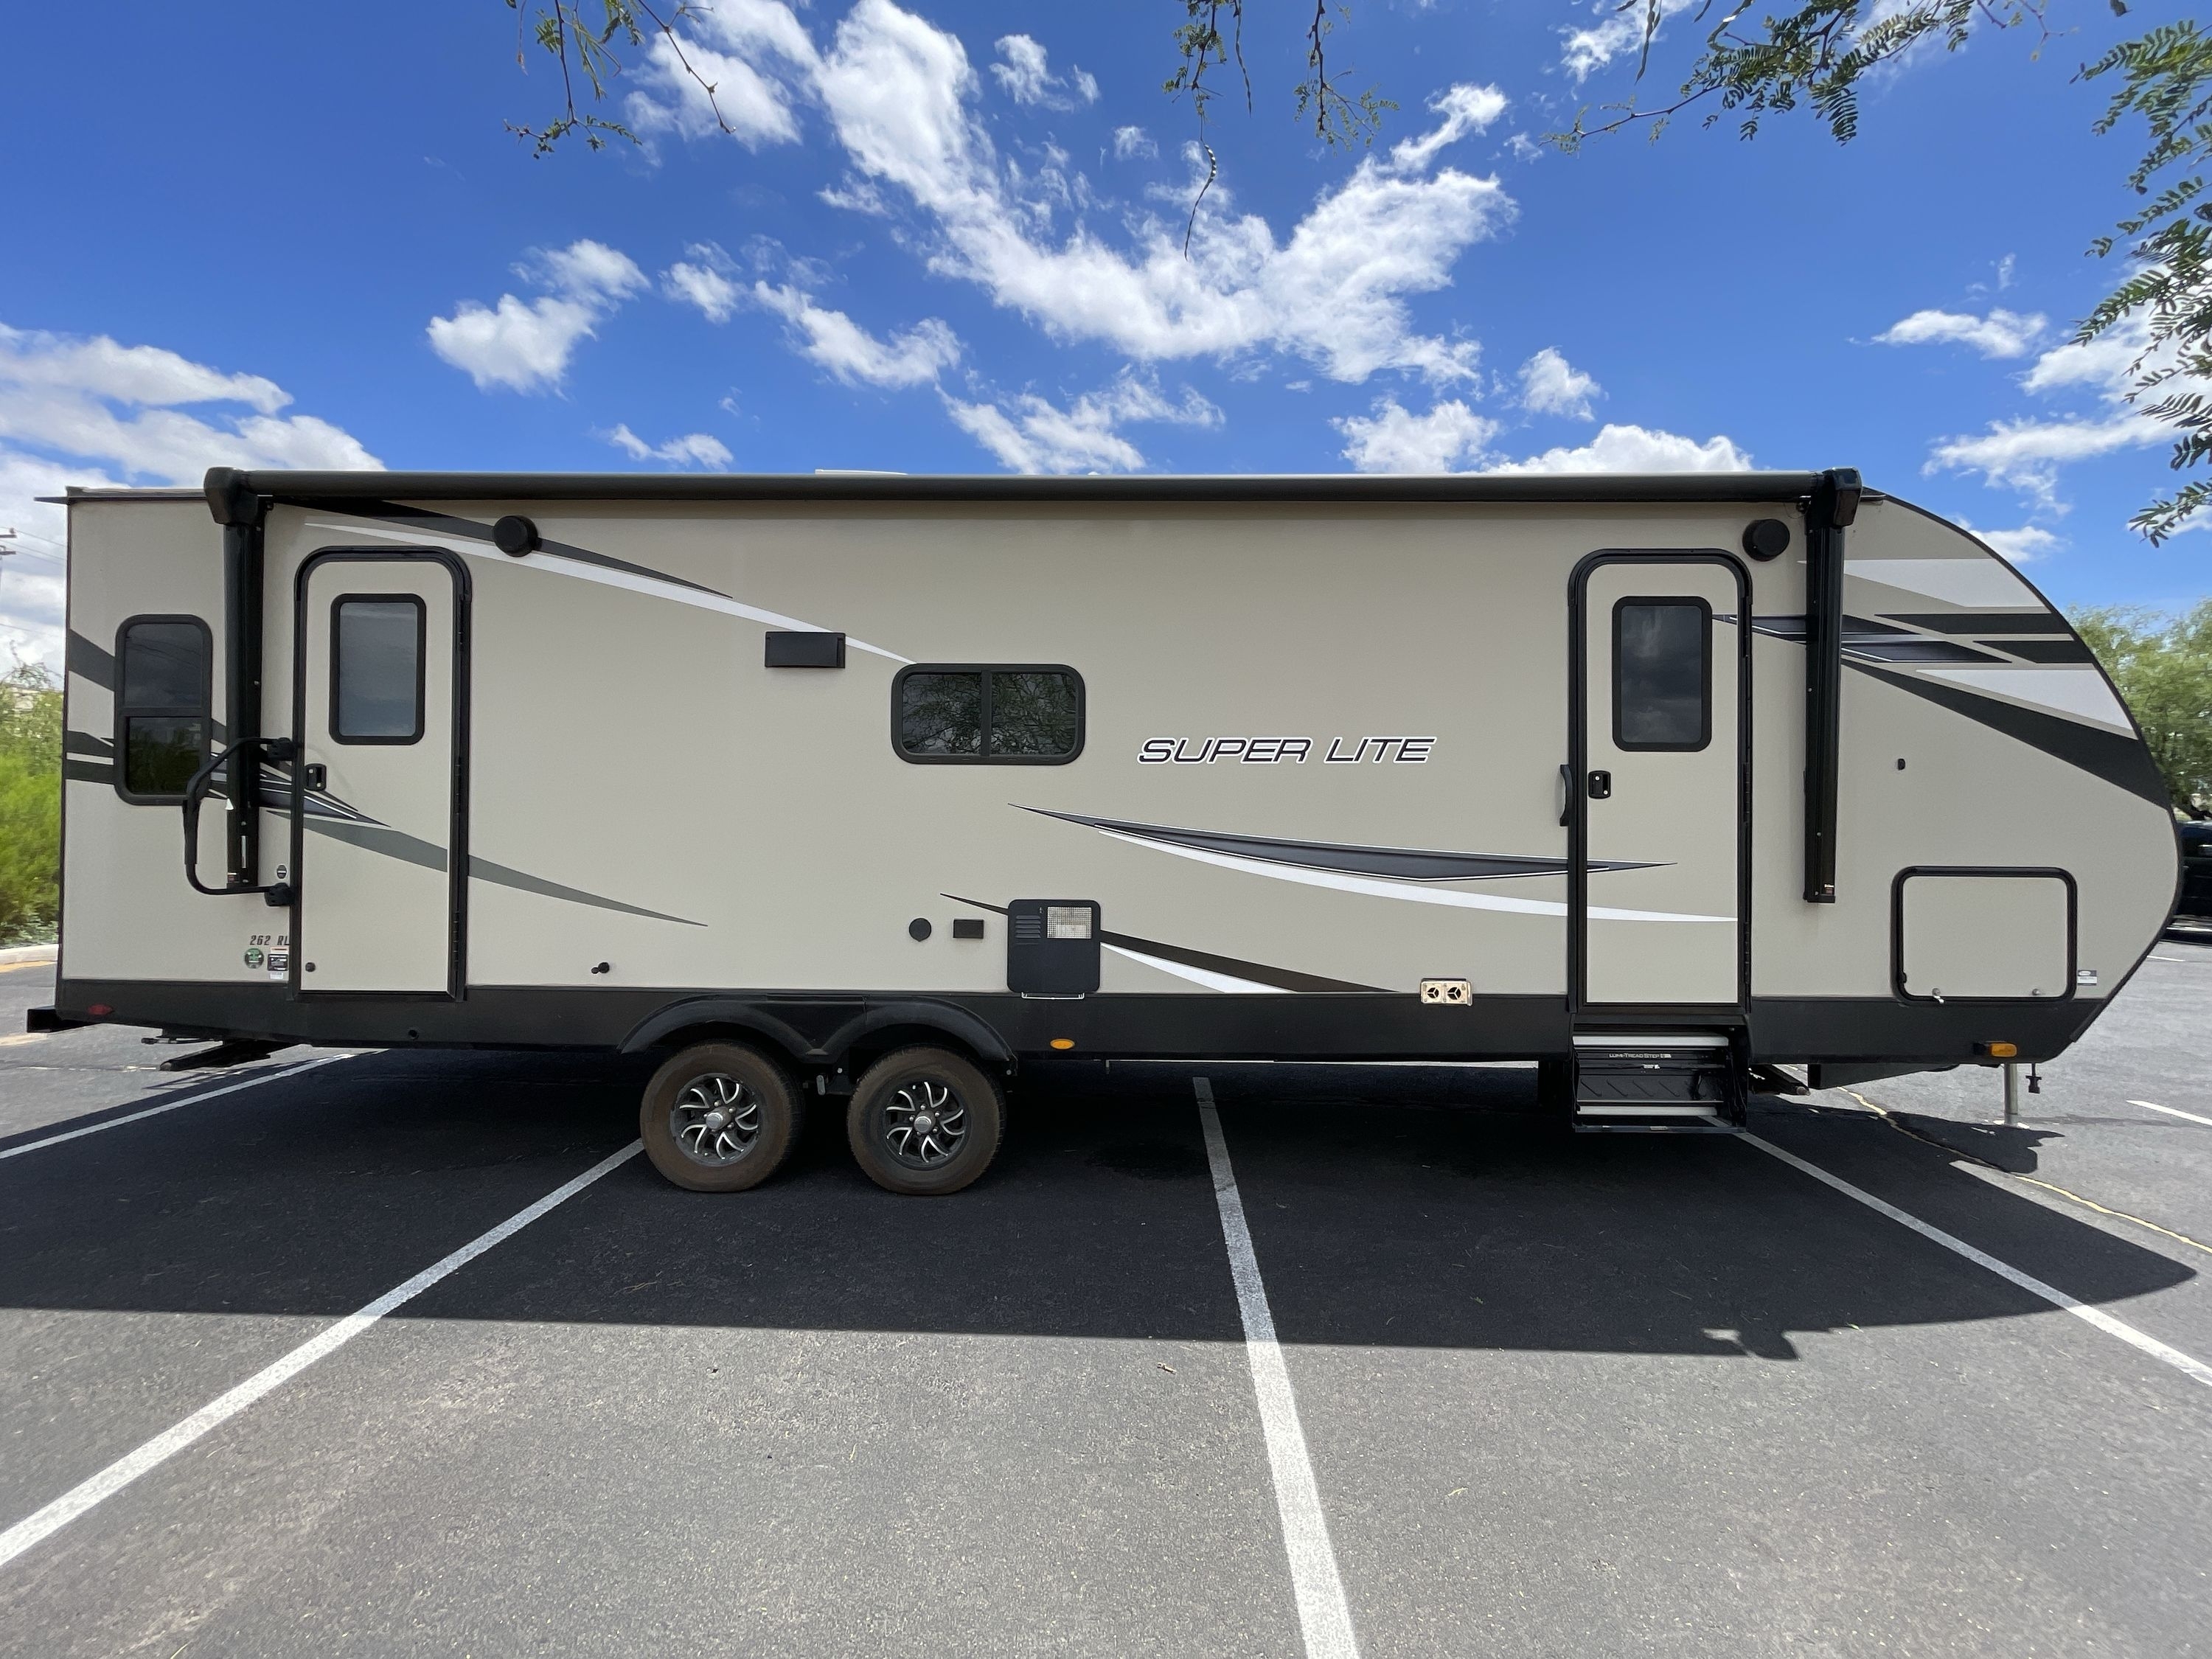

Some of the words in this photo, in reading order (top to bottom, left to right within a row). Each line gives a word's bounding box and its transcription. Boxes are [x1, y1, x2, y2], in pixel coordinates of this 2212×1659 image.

[1137, 737, 1313, 764] SUPER
[1324, 737, 1437, 763] LITE
[249, 935, 271, 945] 262
